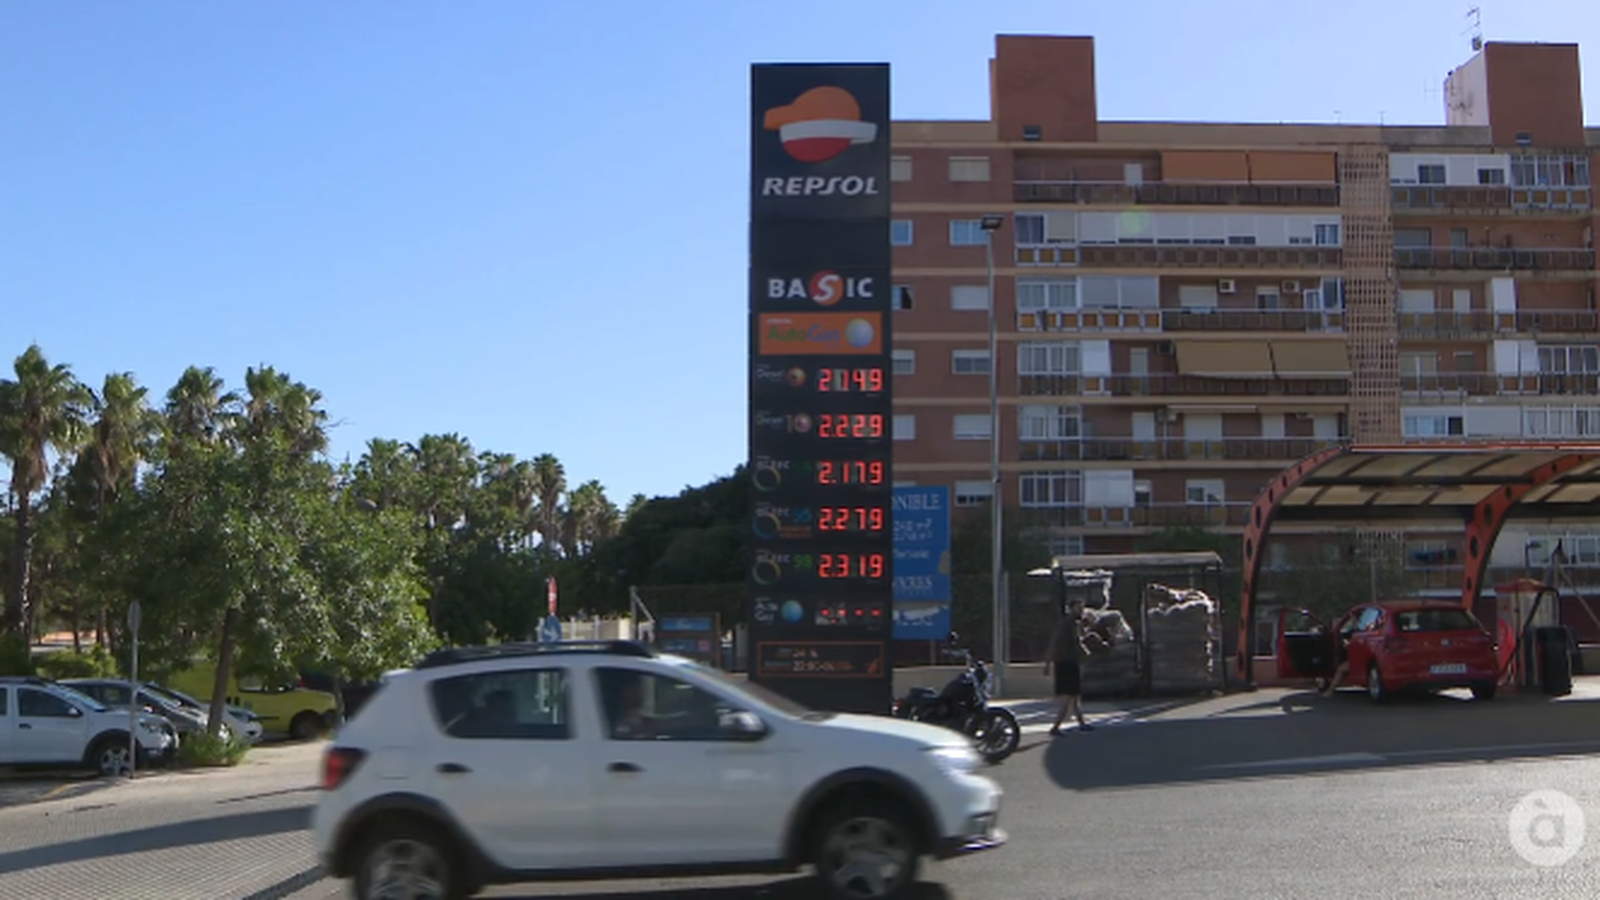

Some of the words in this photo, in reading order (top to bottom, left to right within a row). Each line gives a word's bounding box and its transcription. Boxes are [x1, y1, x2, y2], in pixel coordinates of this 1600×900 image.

[762, 176, 879, 196] REPSOL
[768, 274, 873, 302] BASIC
[818, 414, 883, 438] 2.229
[818, 461, 883, 484] 2.179
[818, 508, 883, 531] 2.279
